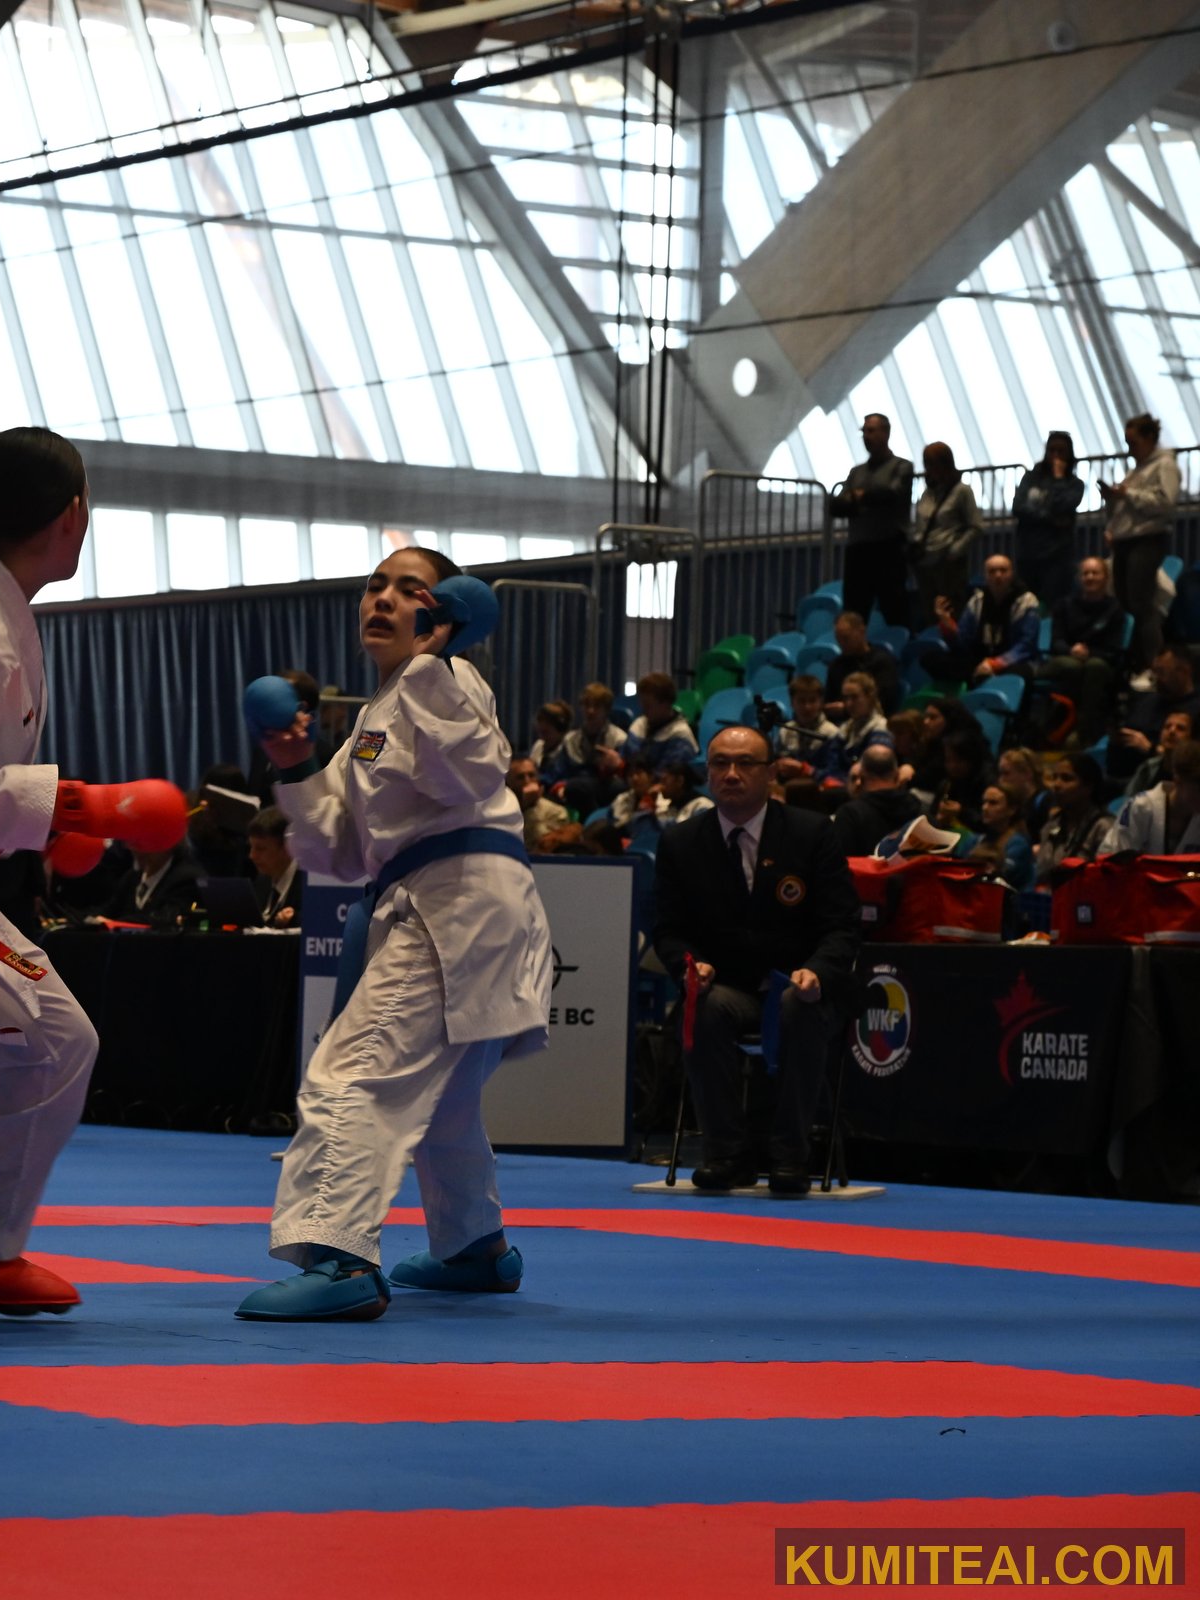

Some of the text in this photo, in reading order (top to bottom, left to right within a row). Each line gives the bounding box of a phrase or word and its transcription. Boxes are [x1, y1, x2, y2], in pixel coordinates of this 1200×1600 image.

[565, 1007, 595, 1026] BC
[866, 1007, 900, 1033] WKF
[1021, 1031, 1089, 1057] KARATE
[1019, 1056, 1089, 1082] CANADA
